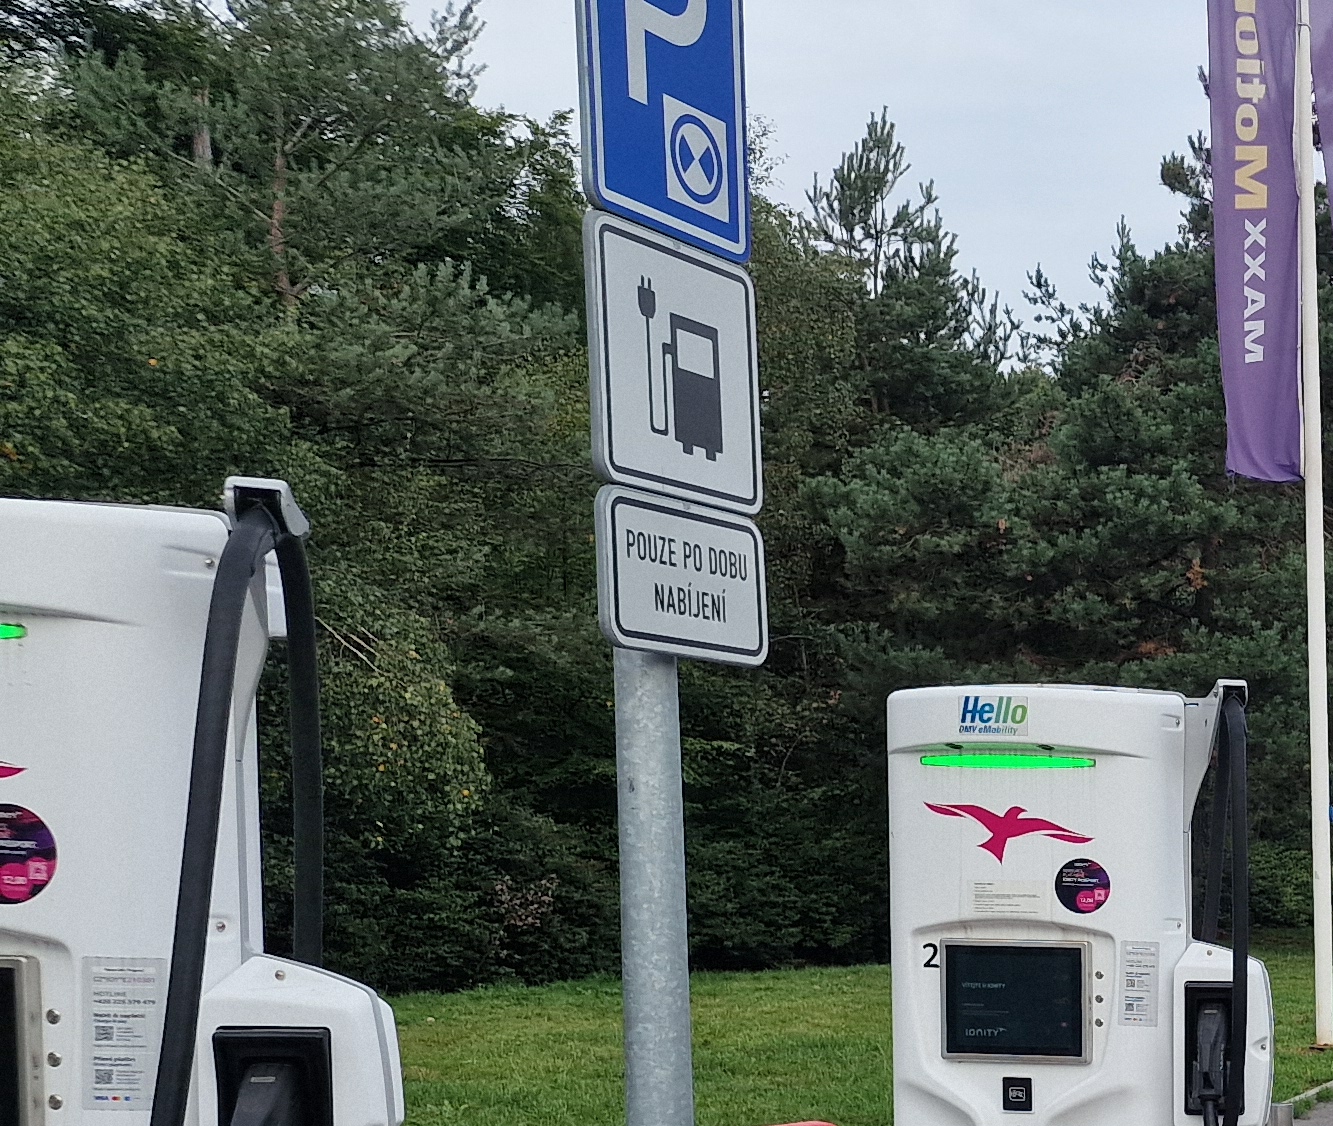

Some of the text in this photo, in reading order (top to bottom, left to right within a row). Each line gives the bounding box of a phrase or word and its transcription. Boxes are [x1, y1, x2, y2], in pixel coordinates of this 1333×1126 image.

[625, 528, 748, 582] POUZE PO DOBU
[653, 581, 727, 623] NABÍJENÍ
[960, 695, 1028, 725] Hello
[978, 725, 1018, 736] eMobility
[922, 942, 940, 969] 2
[965, 1028, 999, 1037] IONITY
